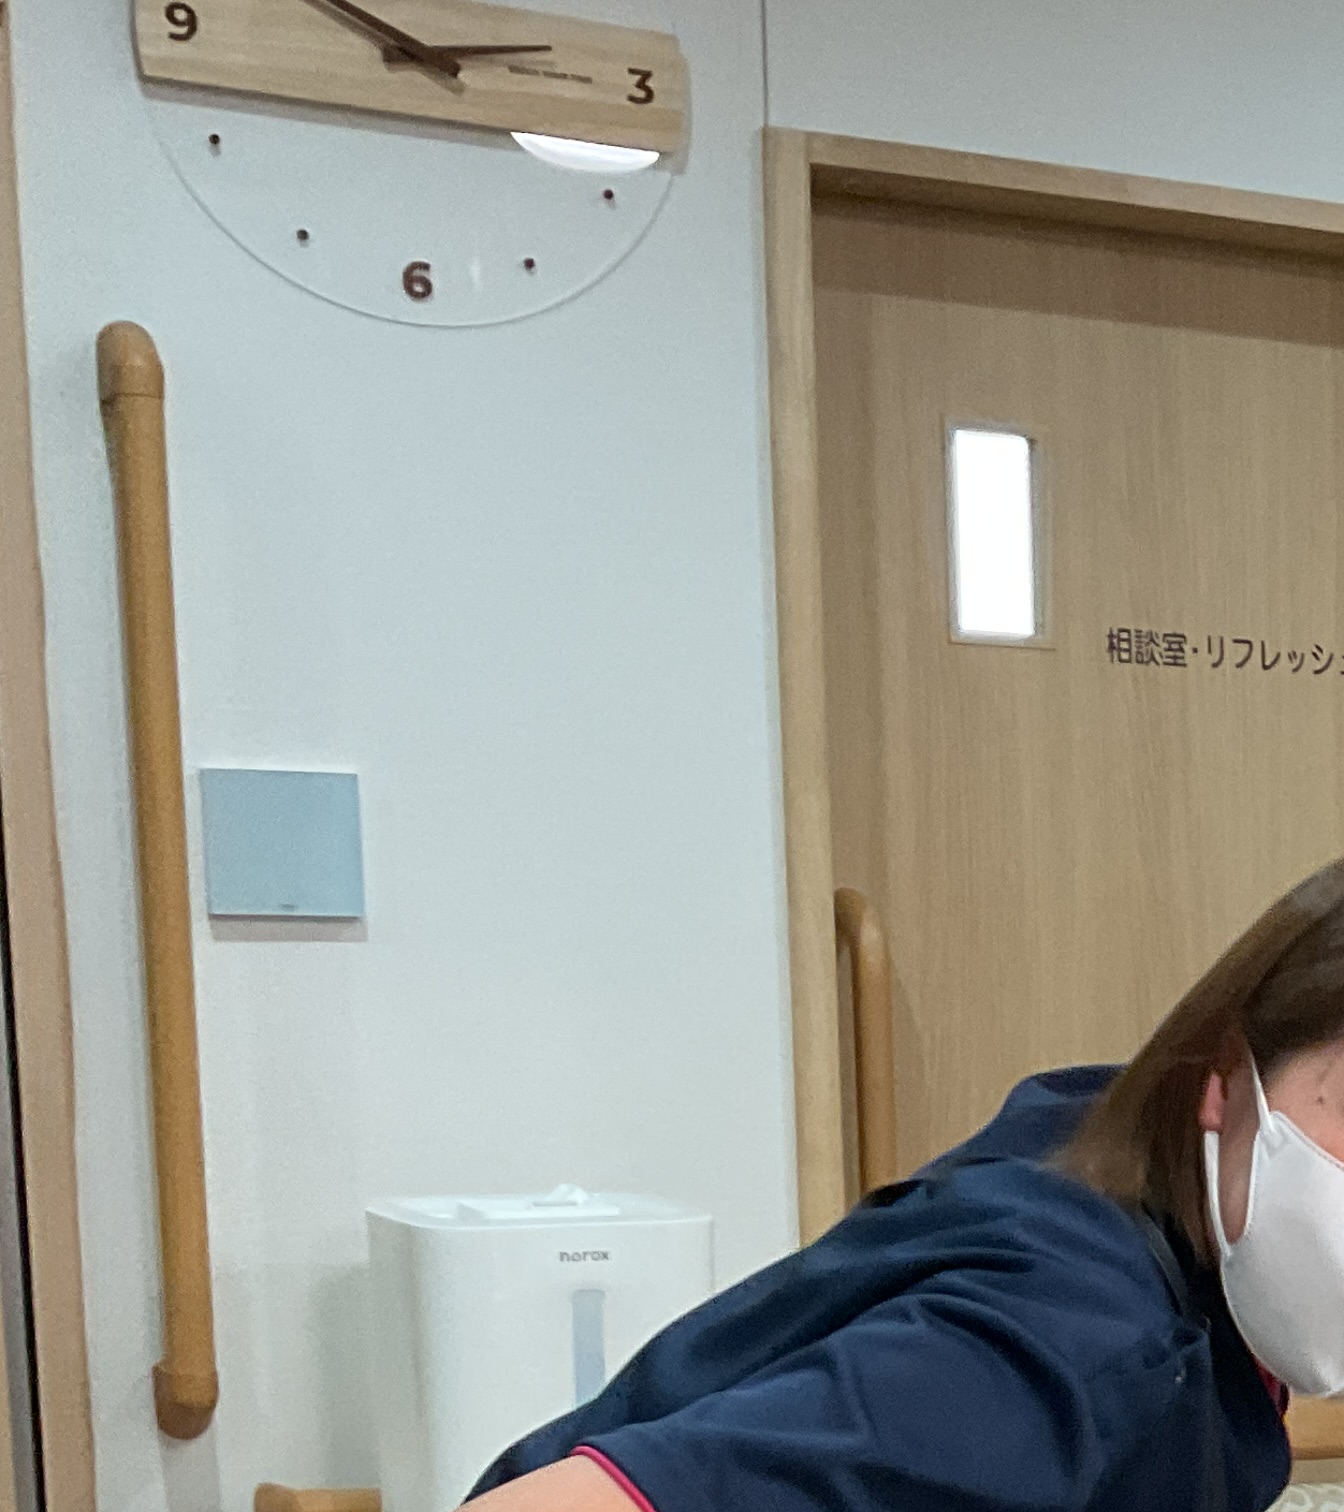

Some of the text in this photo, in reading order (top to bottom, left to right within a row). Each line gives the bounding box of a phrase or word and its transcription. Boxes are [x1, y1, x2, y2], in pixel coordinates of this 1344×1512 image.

[165, 2, 197, 41] 9
[627, 67, 654, 105] 3
[402, 260, 432, 301] 6
